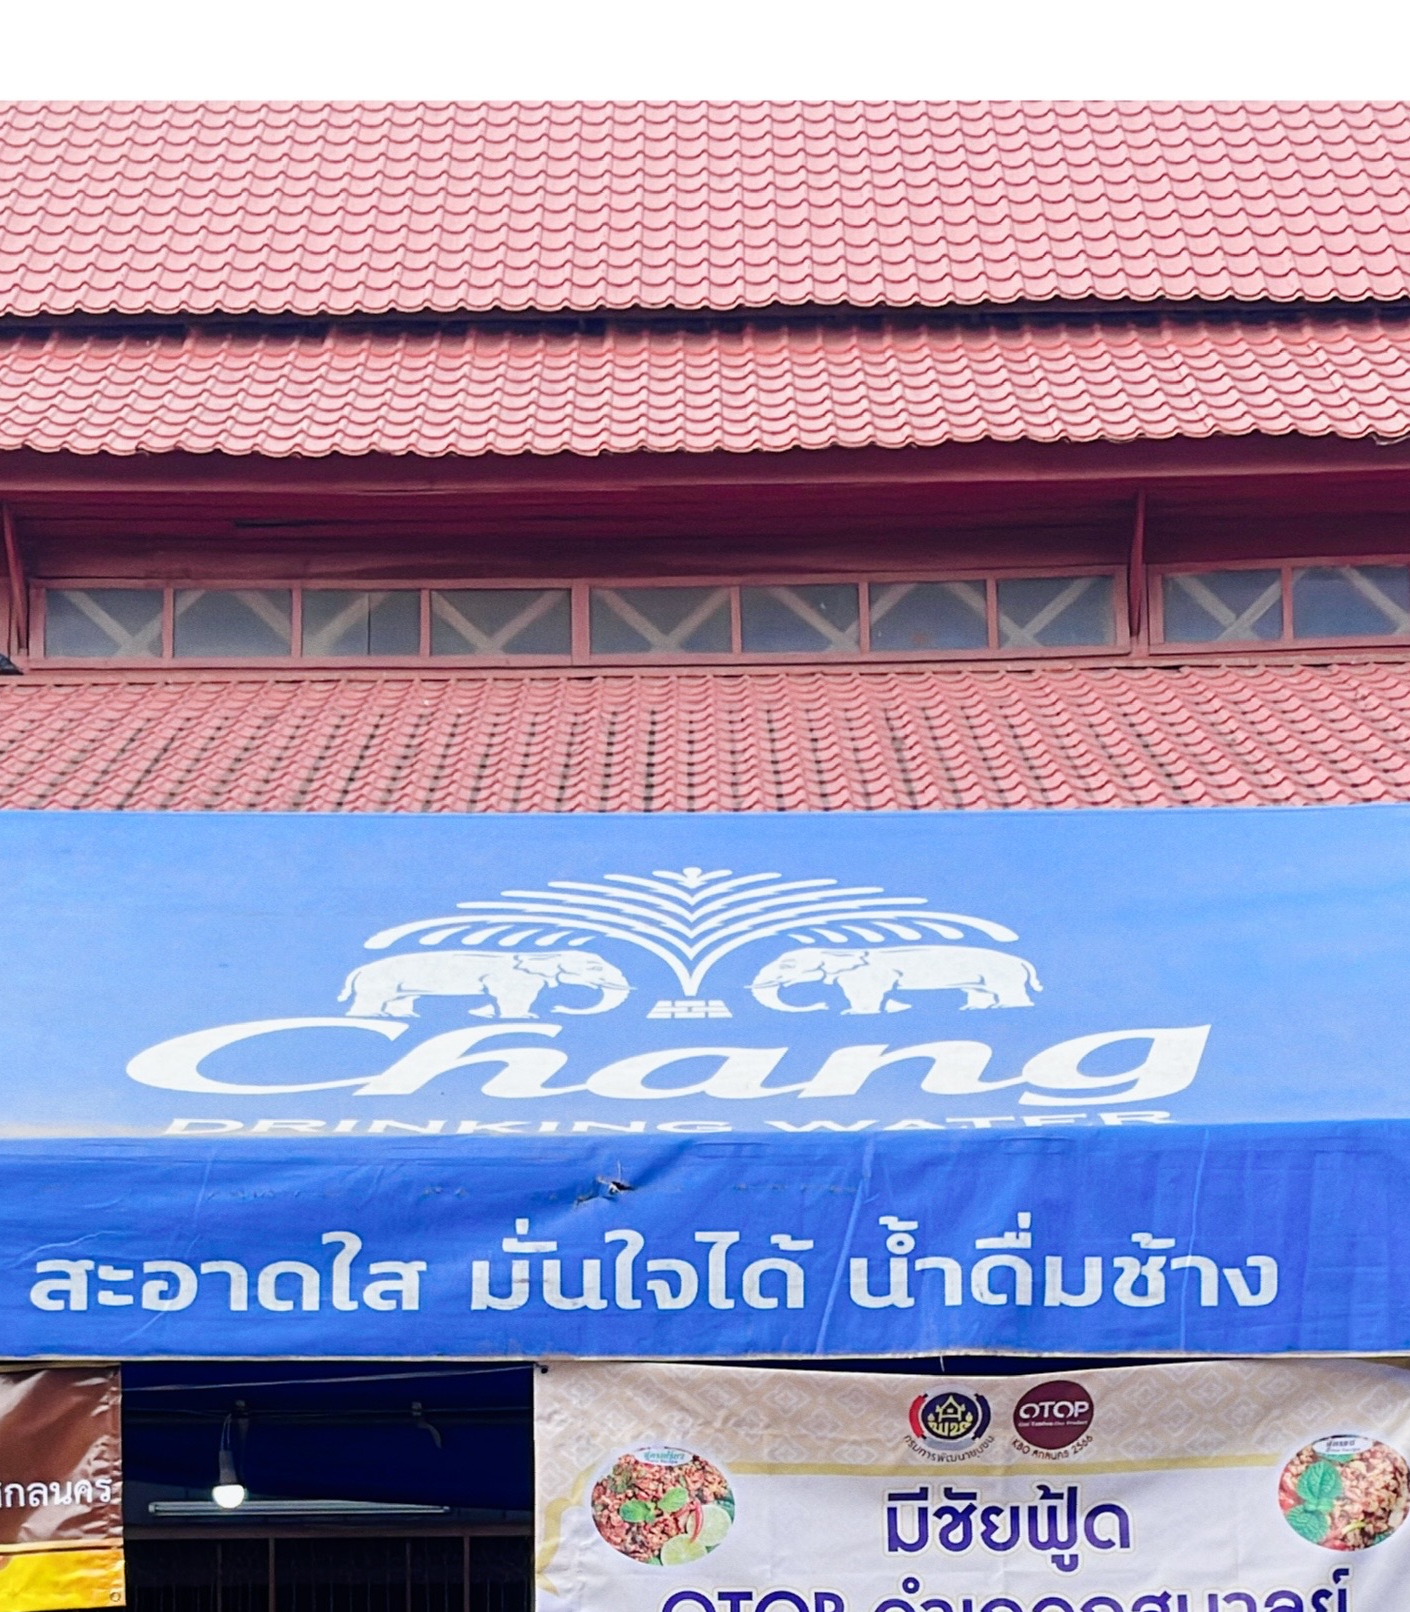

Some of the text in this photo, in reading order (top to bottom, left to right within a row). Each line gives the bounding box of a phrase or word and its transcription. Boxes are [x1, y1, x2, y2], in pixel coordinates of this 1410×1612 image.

[126, 1017, 1212, 1106] Chang
[163, 1117, 733, 1135] DRINKING
[30, 1212, 1279, 1312] สะอาดใส มั่นใจได้ น้ำดื่มช้าง
[1019, 1401, 1089, 1419] OTOP
[904, 1435, 995, 1463] กรมการพัฒนาชุมชน
[1012, 1438, 1031, 1454] KBO
[886, 1483, 1131, 1573] มีชัยฟู้ด
